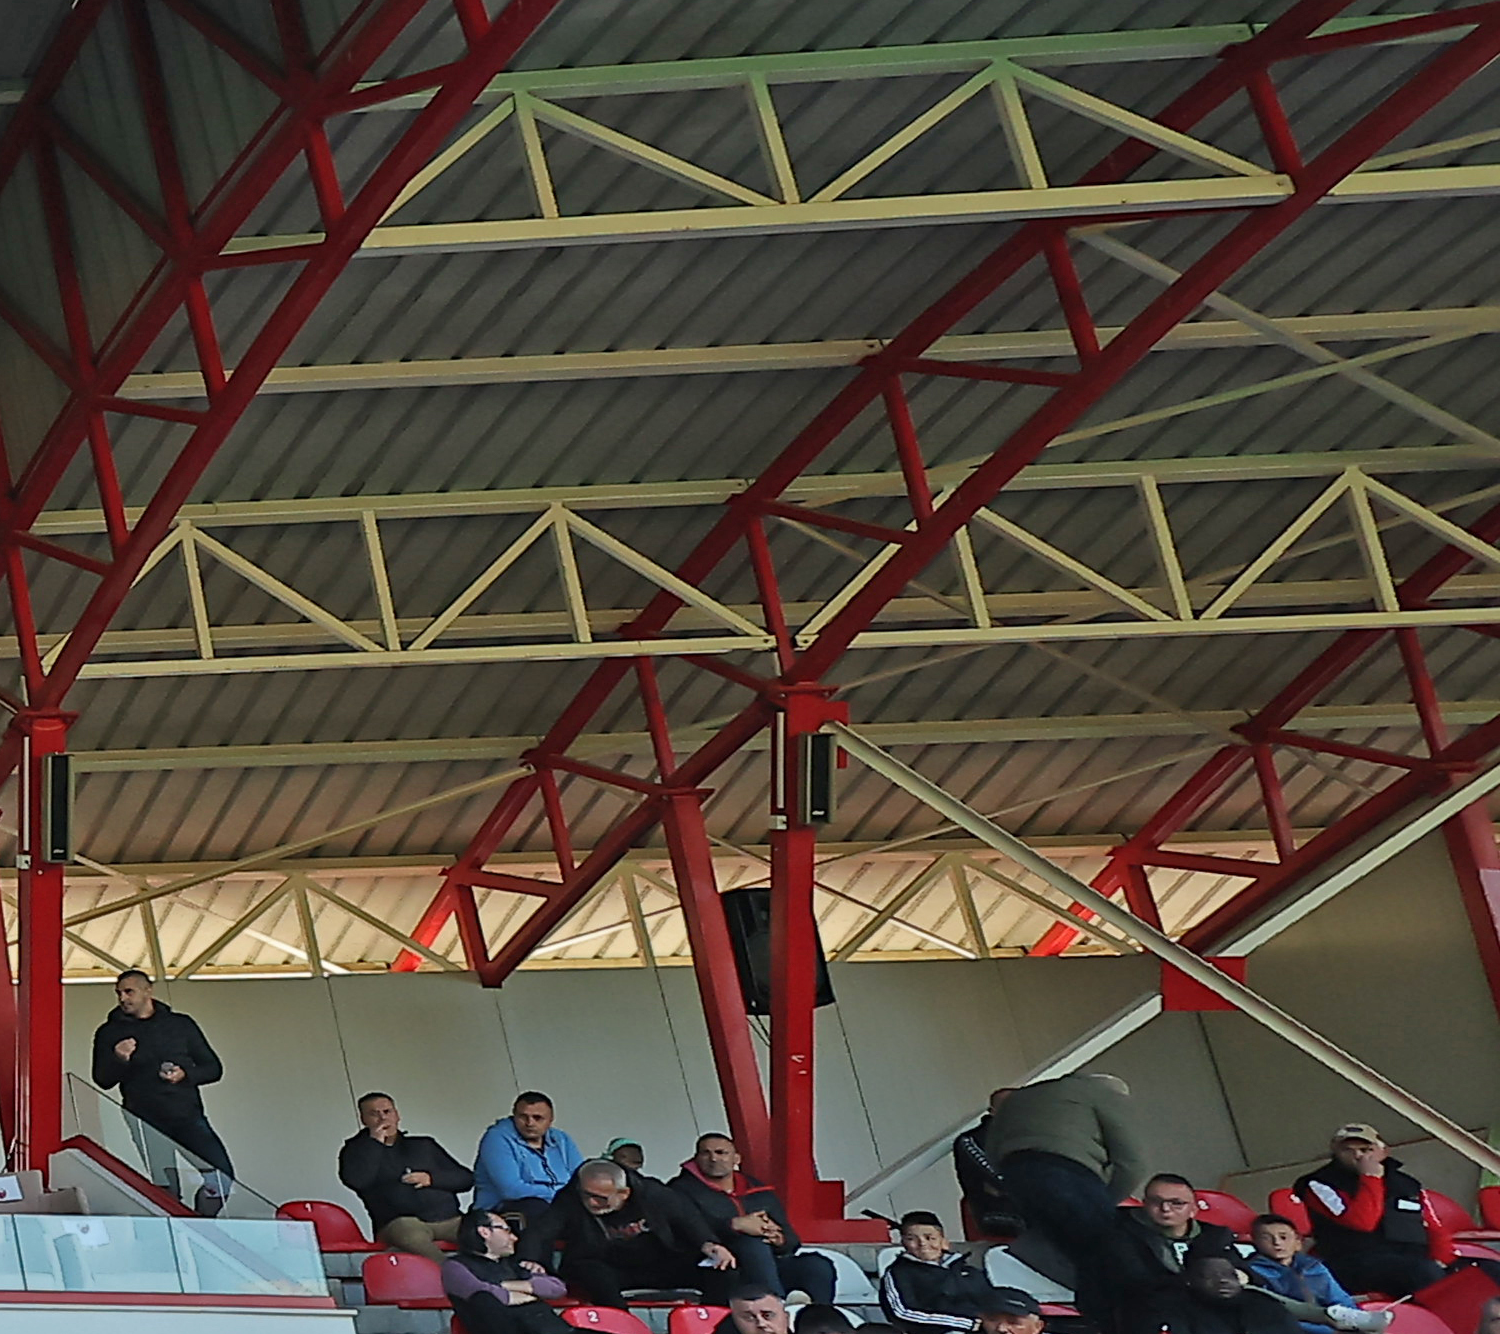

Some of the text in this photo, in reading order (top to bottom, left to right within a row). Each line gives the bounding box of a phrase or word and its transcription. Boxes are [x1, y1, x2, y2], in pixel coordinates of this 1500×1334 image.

[305, 1203, 311, 1212] 1
[389, 1255, 398, 1266] 1
[588, 1311, 599, 1322] 2
